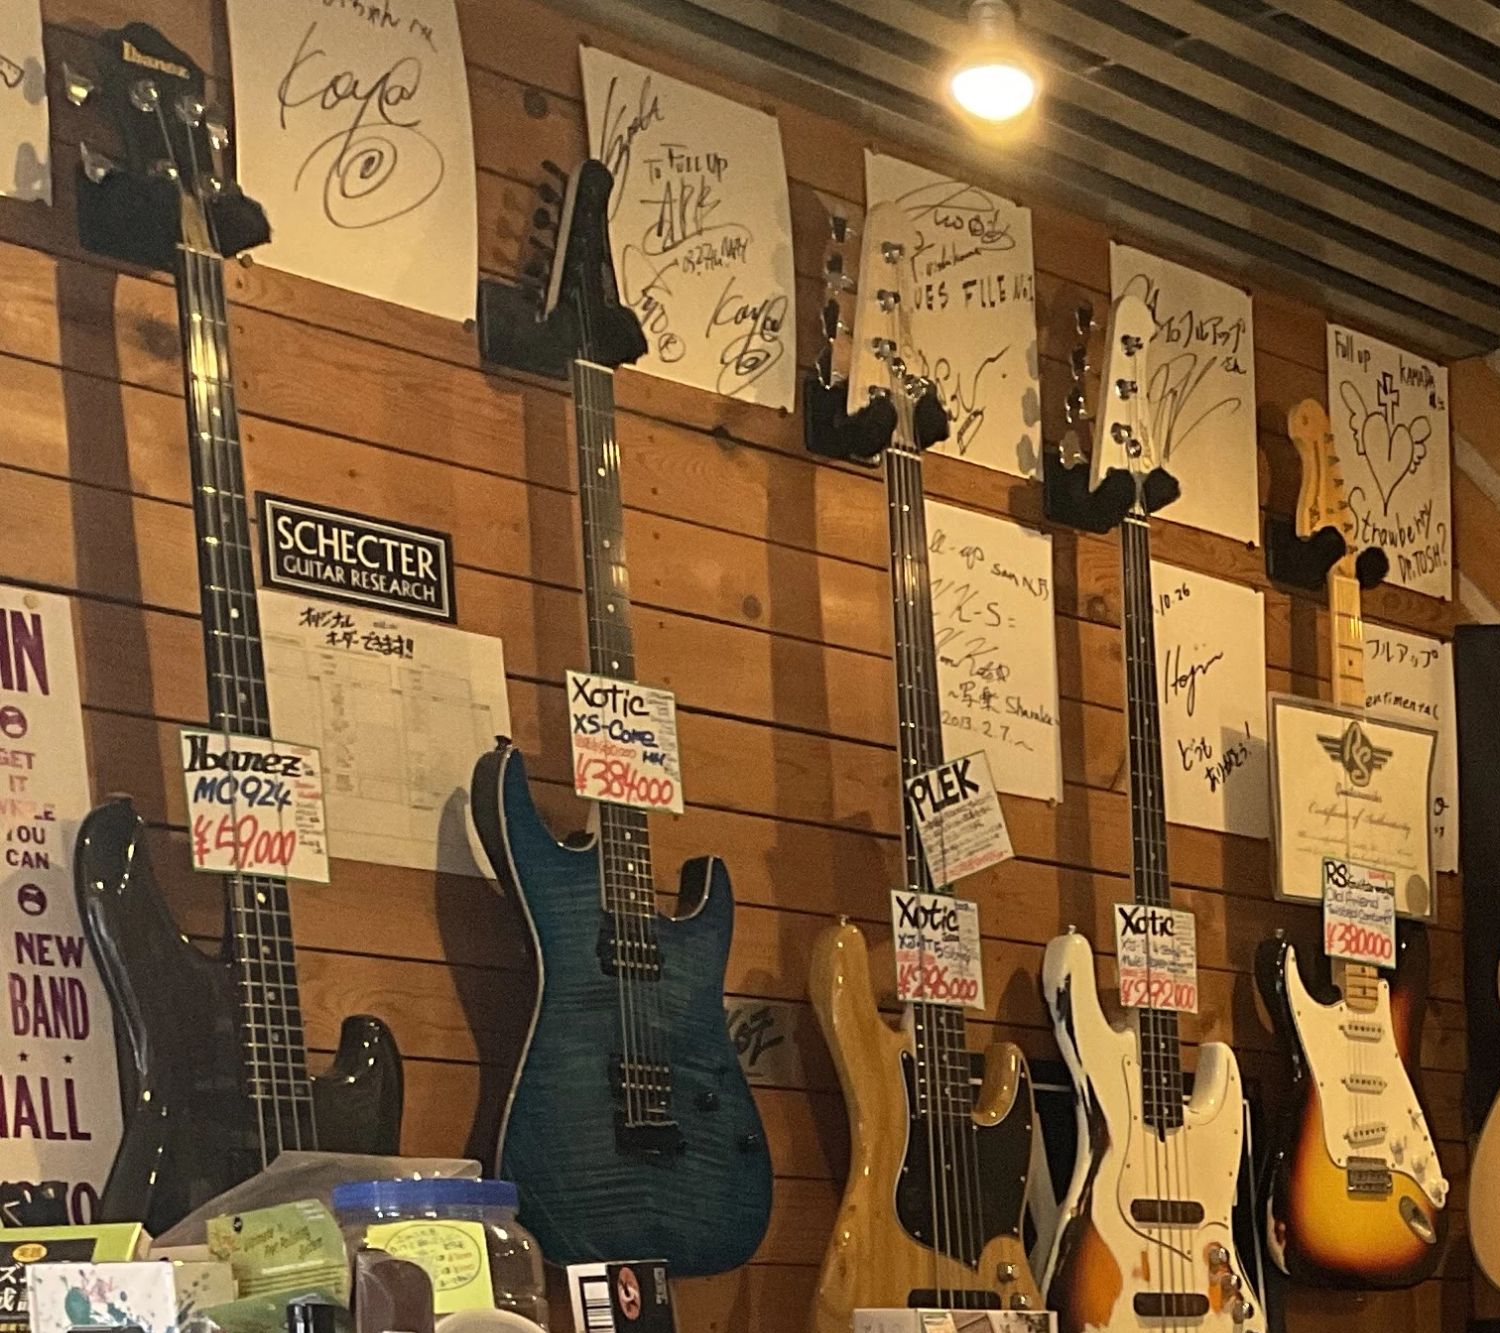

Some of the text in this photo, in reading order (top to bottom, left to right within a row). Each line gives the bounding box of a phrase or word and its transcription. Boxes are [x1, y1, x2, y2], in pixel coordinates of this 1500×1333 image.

[277, 515, 437, 581] SCHECTER
[283, 554, 436, 602] GUITAR RESEARCH
[573, 676, 650, 717] Xotic
[184, 736, 302, 777] Ibanez
[908, 758, 980, 822] PLEK
[6, 848, 50, 870] CAN
[896, 895, 960, 932] Xotic
[1119, 907, 1175, 937] Xotic
[15, 931, 85, 969] NEW
[9, 973, 91, 1041] BAND
